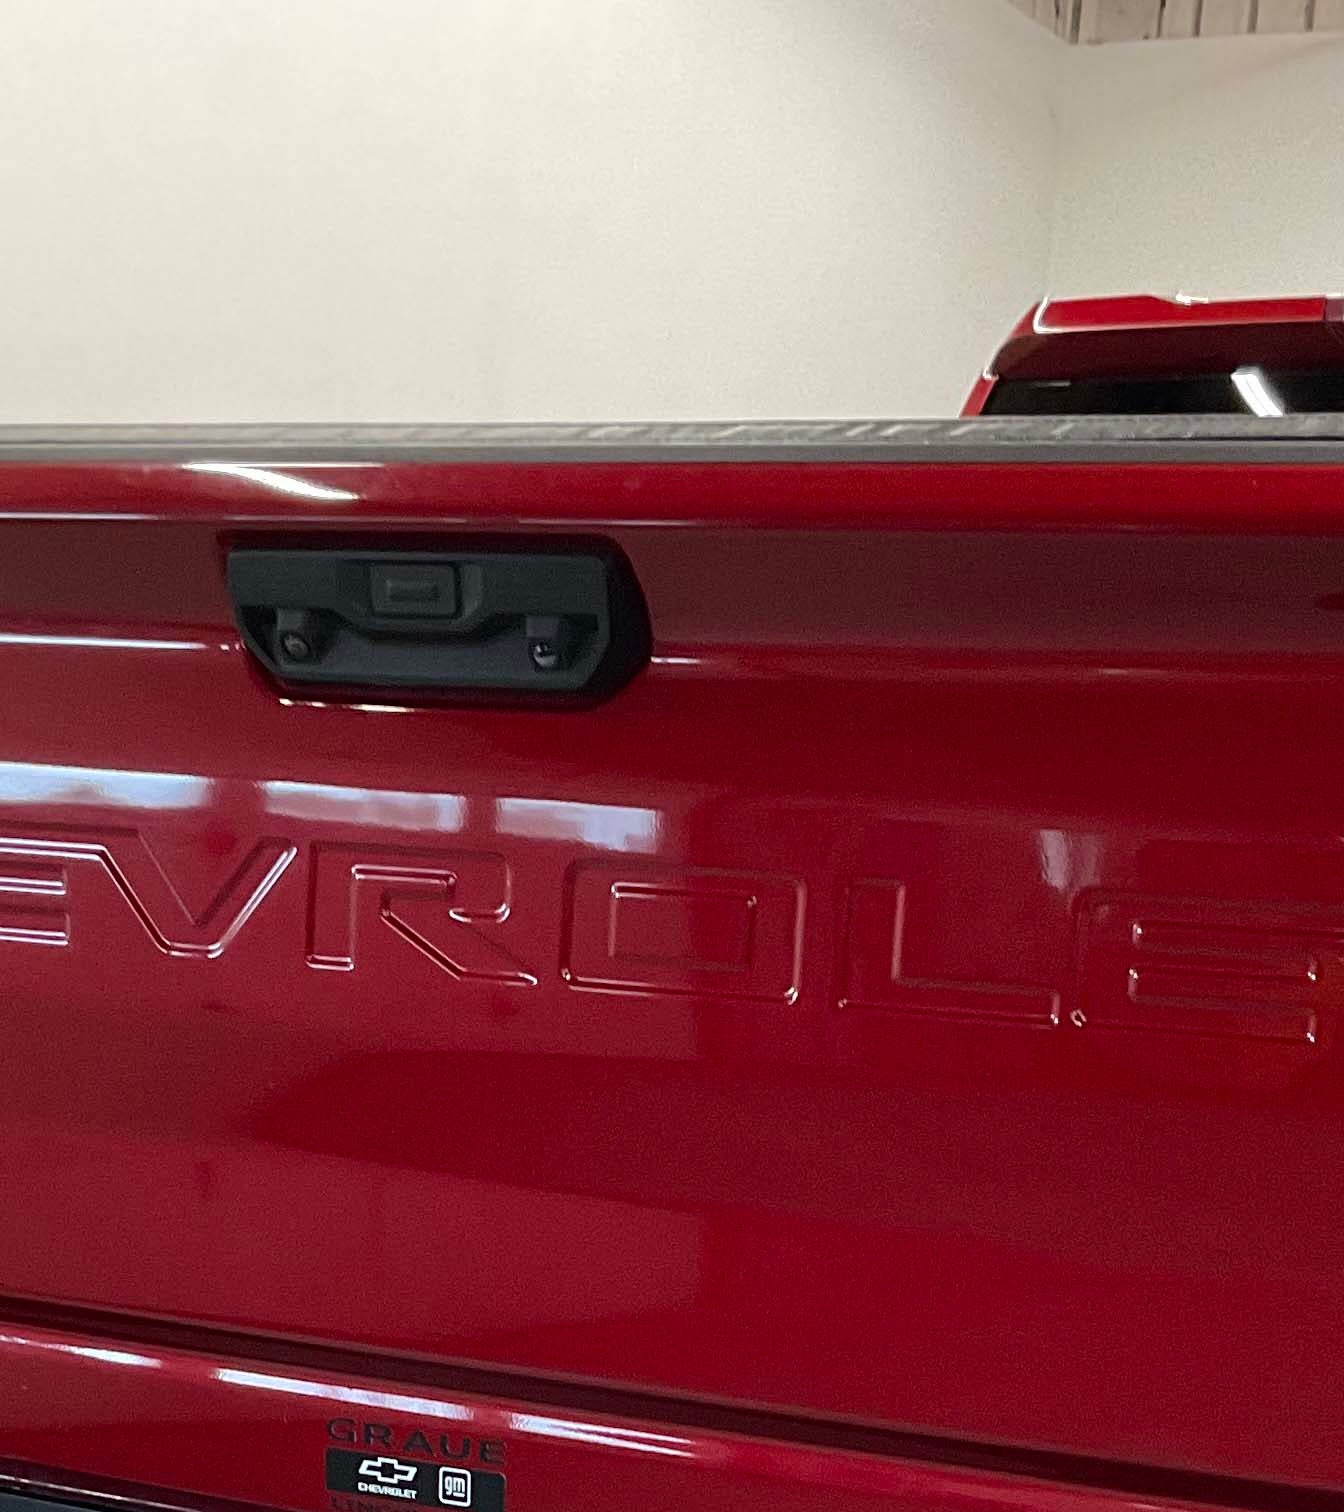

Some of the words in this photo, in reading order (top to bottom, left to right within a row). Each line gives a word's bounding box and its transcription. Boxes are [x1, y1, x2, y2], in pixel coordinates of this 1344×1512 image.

[325, 1417, 506, 1465] GRAUE
[357, 1481, 417, 1500] CHEVROLET
[444, 1477, 466, 1498] gm
